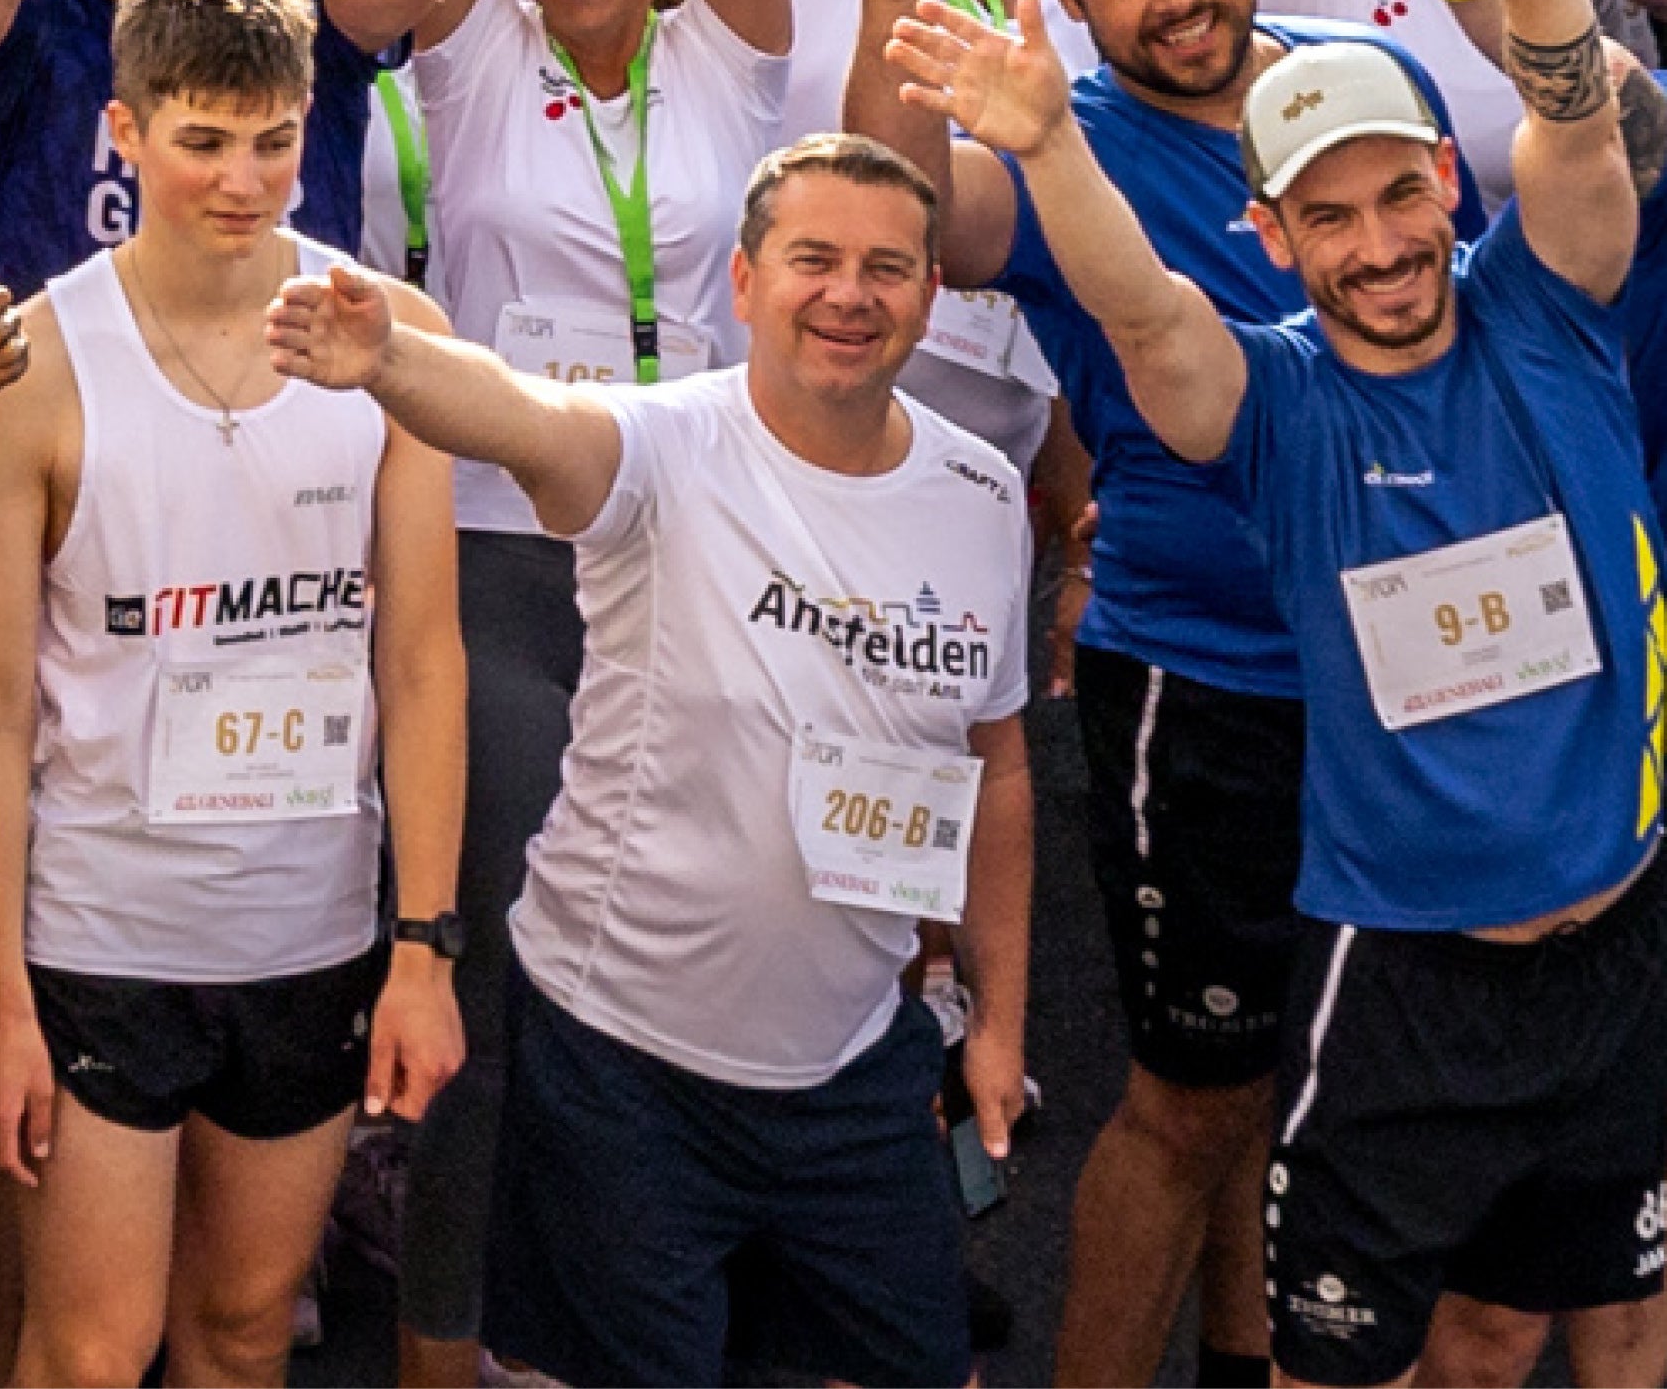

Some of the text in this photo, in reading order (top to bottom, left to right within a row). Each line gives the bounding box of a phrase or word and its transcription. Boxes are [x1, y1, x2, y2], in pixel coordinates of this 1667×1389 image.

[1434, 590, 1512, 647] 9-B
[214, 707, 305, 757] 67-C
[821, 788, 932, 848] 206-B
